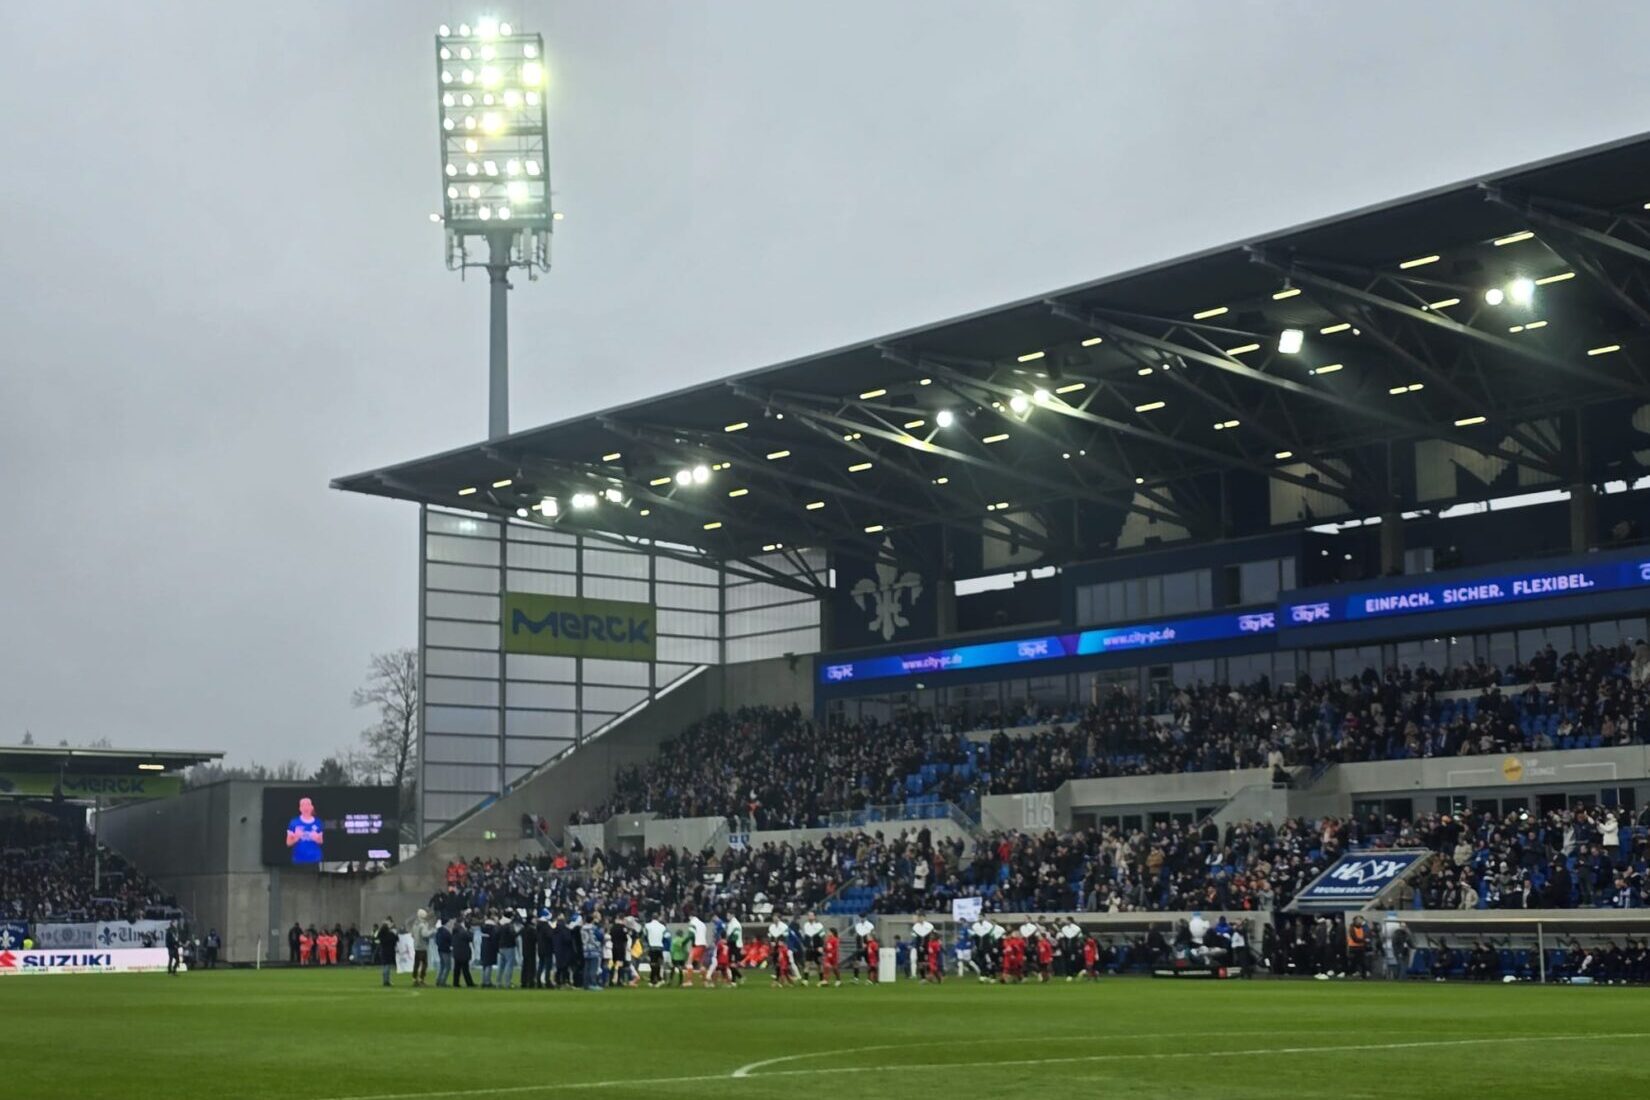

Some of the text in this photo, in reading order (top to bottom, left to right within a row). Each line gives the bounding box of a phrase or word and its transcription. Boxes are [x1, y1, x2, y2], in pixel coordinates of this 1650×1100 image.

[1365, 573, 1594, 613] EINFACH. SICHER. FLEXIBEL.
[23, 954, 111, 967] SUZUKI
